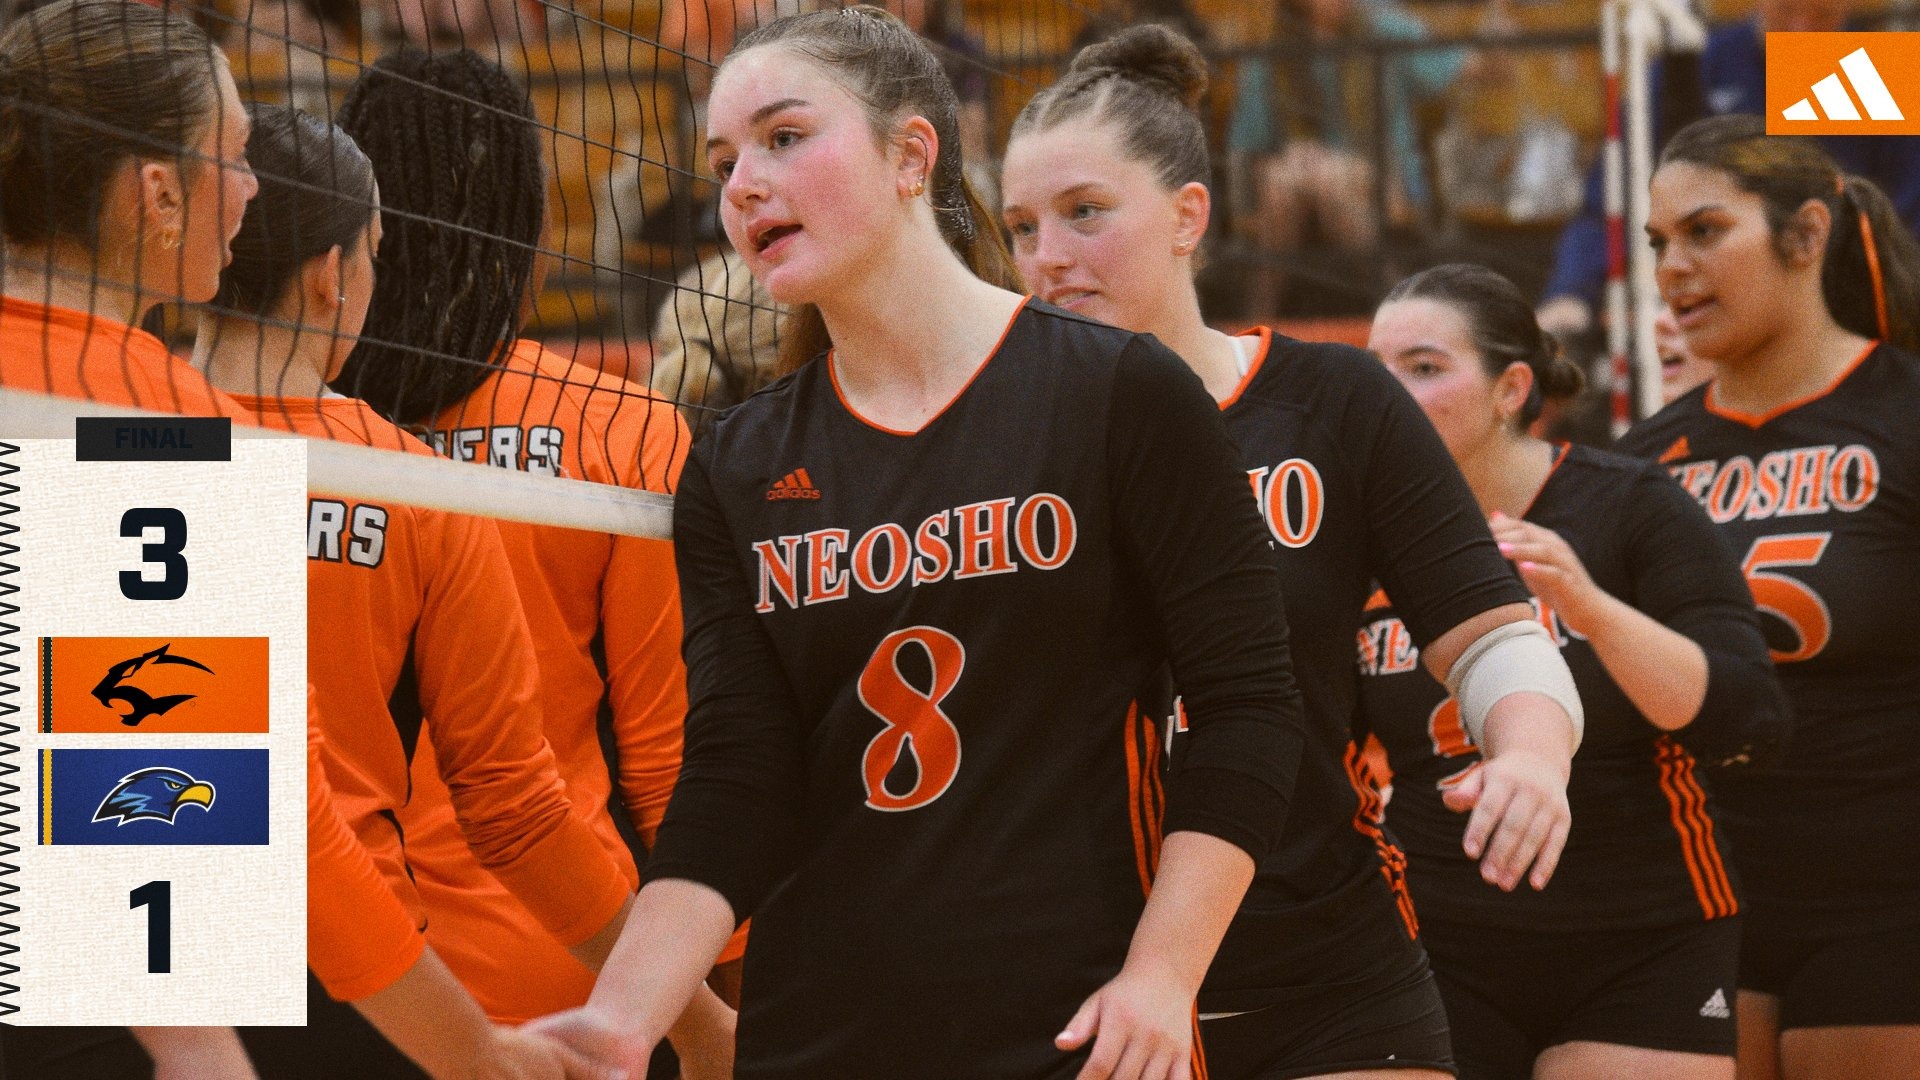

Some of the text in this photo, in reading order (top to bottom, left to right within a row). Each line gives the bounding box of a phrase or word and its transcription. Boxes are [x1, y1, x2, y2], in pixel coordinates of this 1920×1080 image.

[752, 493, 1078, 614] NEOSHO
[766, 488, 822, 501] adidas
[1740, 531, 1832, 664] 5
[857, 625, 966, 812] 8
